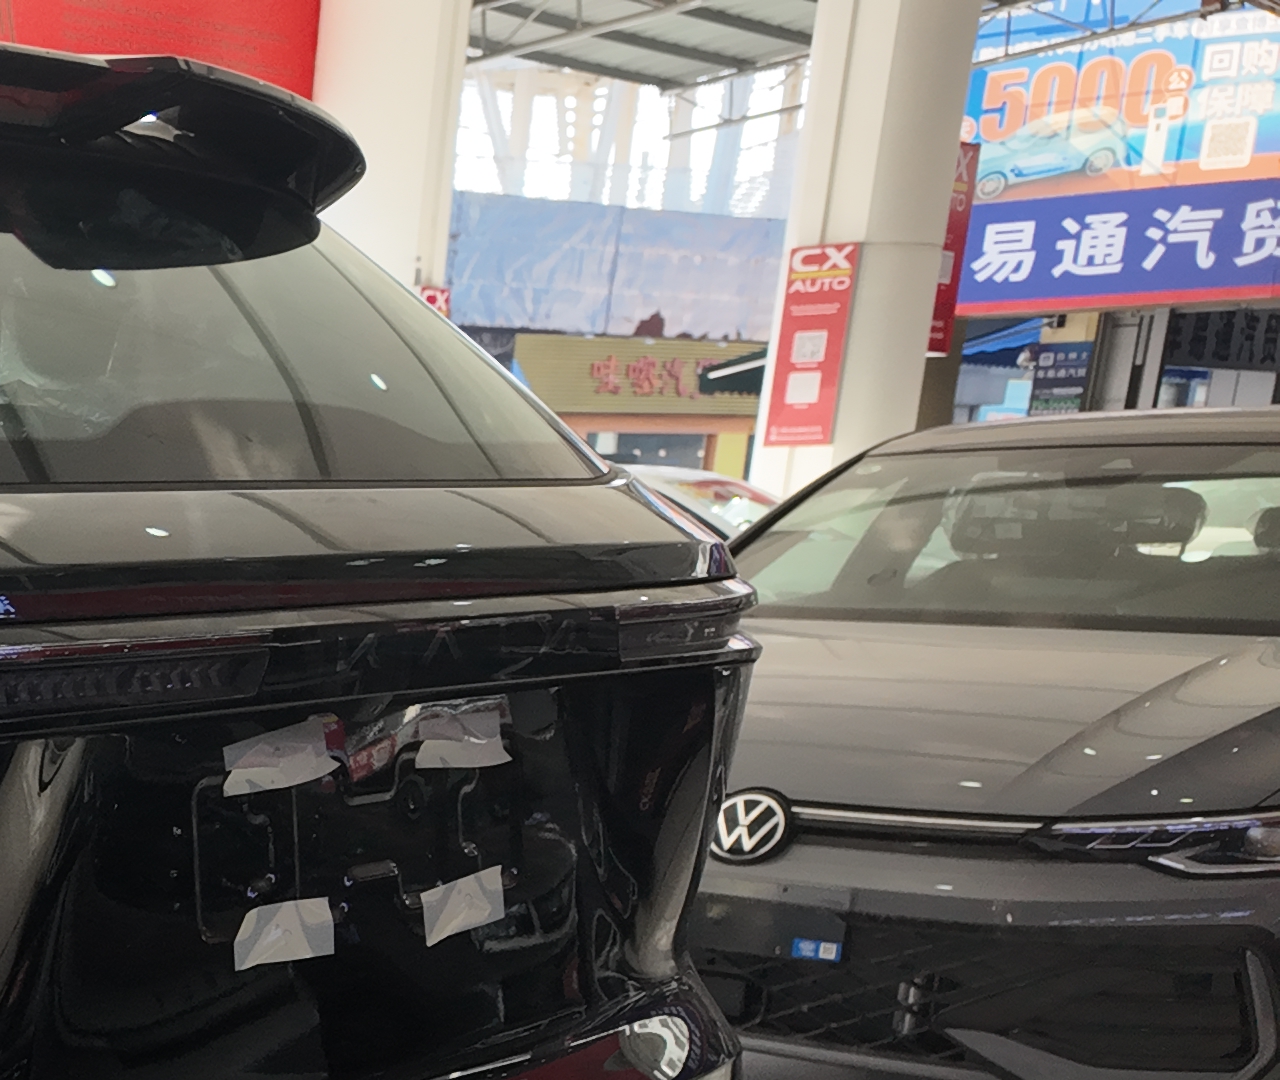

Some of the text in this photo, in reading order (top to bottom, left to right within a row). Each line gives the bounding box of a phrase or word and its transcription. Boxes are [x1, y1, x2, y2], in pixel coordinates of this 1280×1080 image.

[970, 197, 1280, 284] 易通汽贸
[791, 244, 856, 272] CX
[788, 277, 851, 293] AUTO
